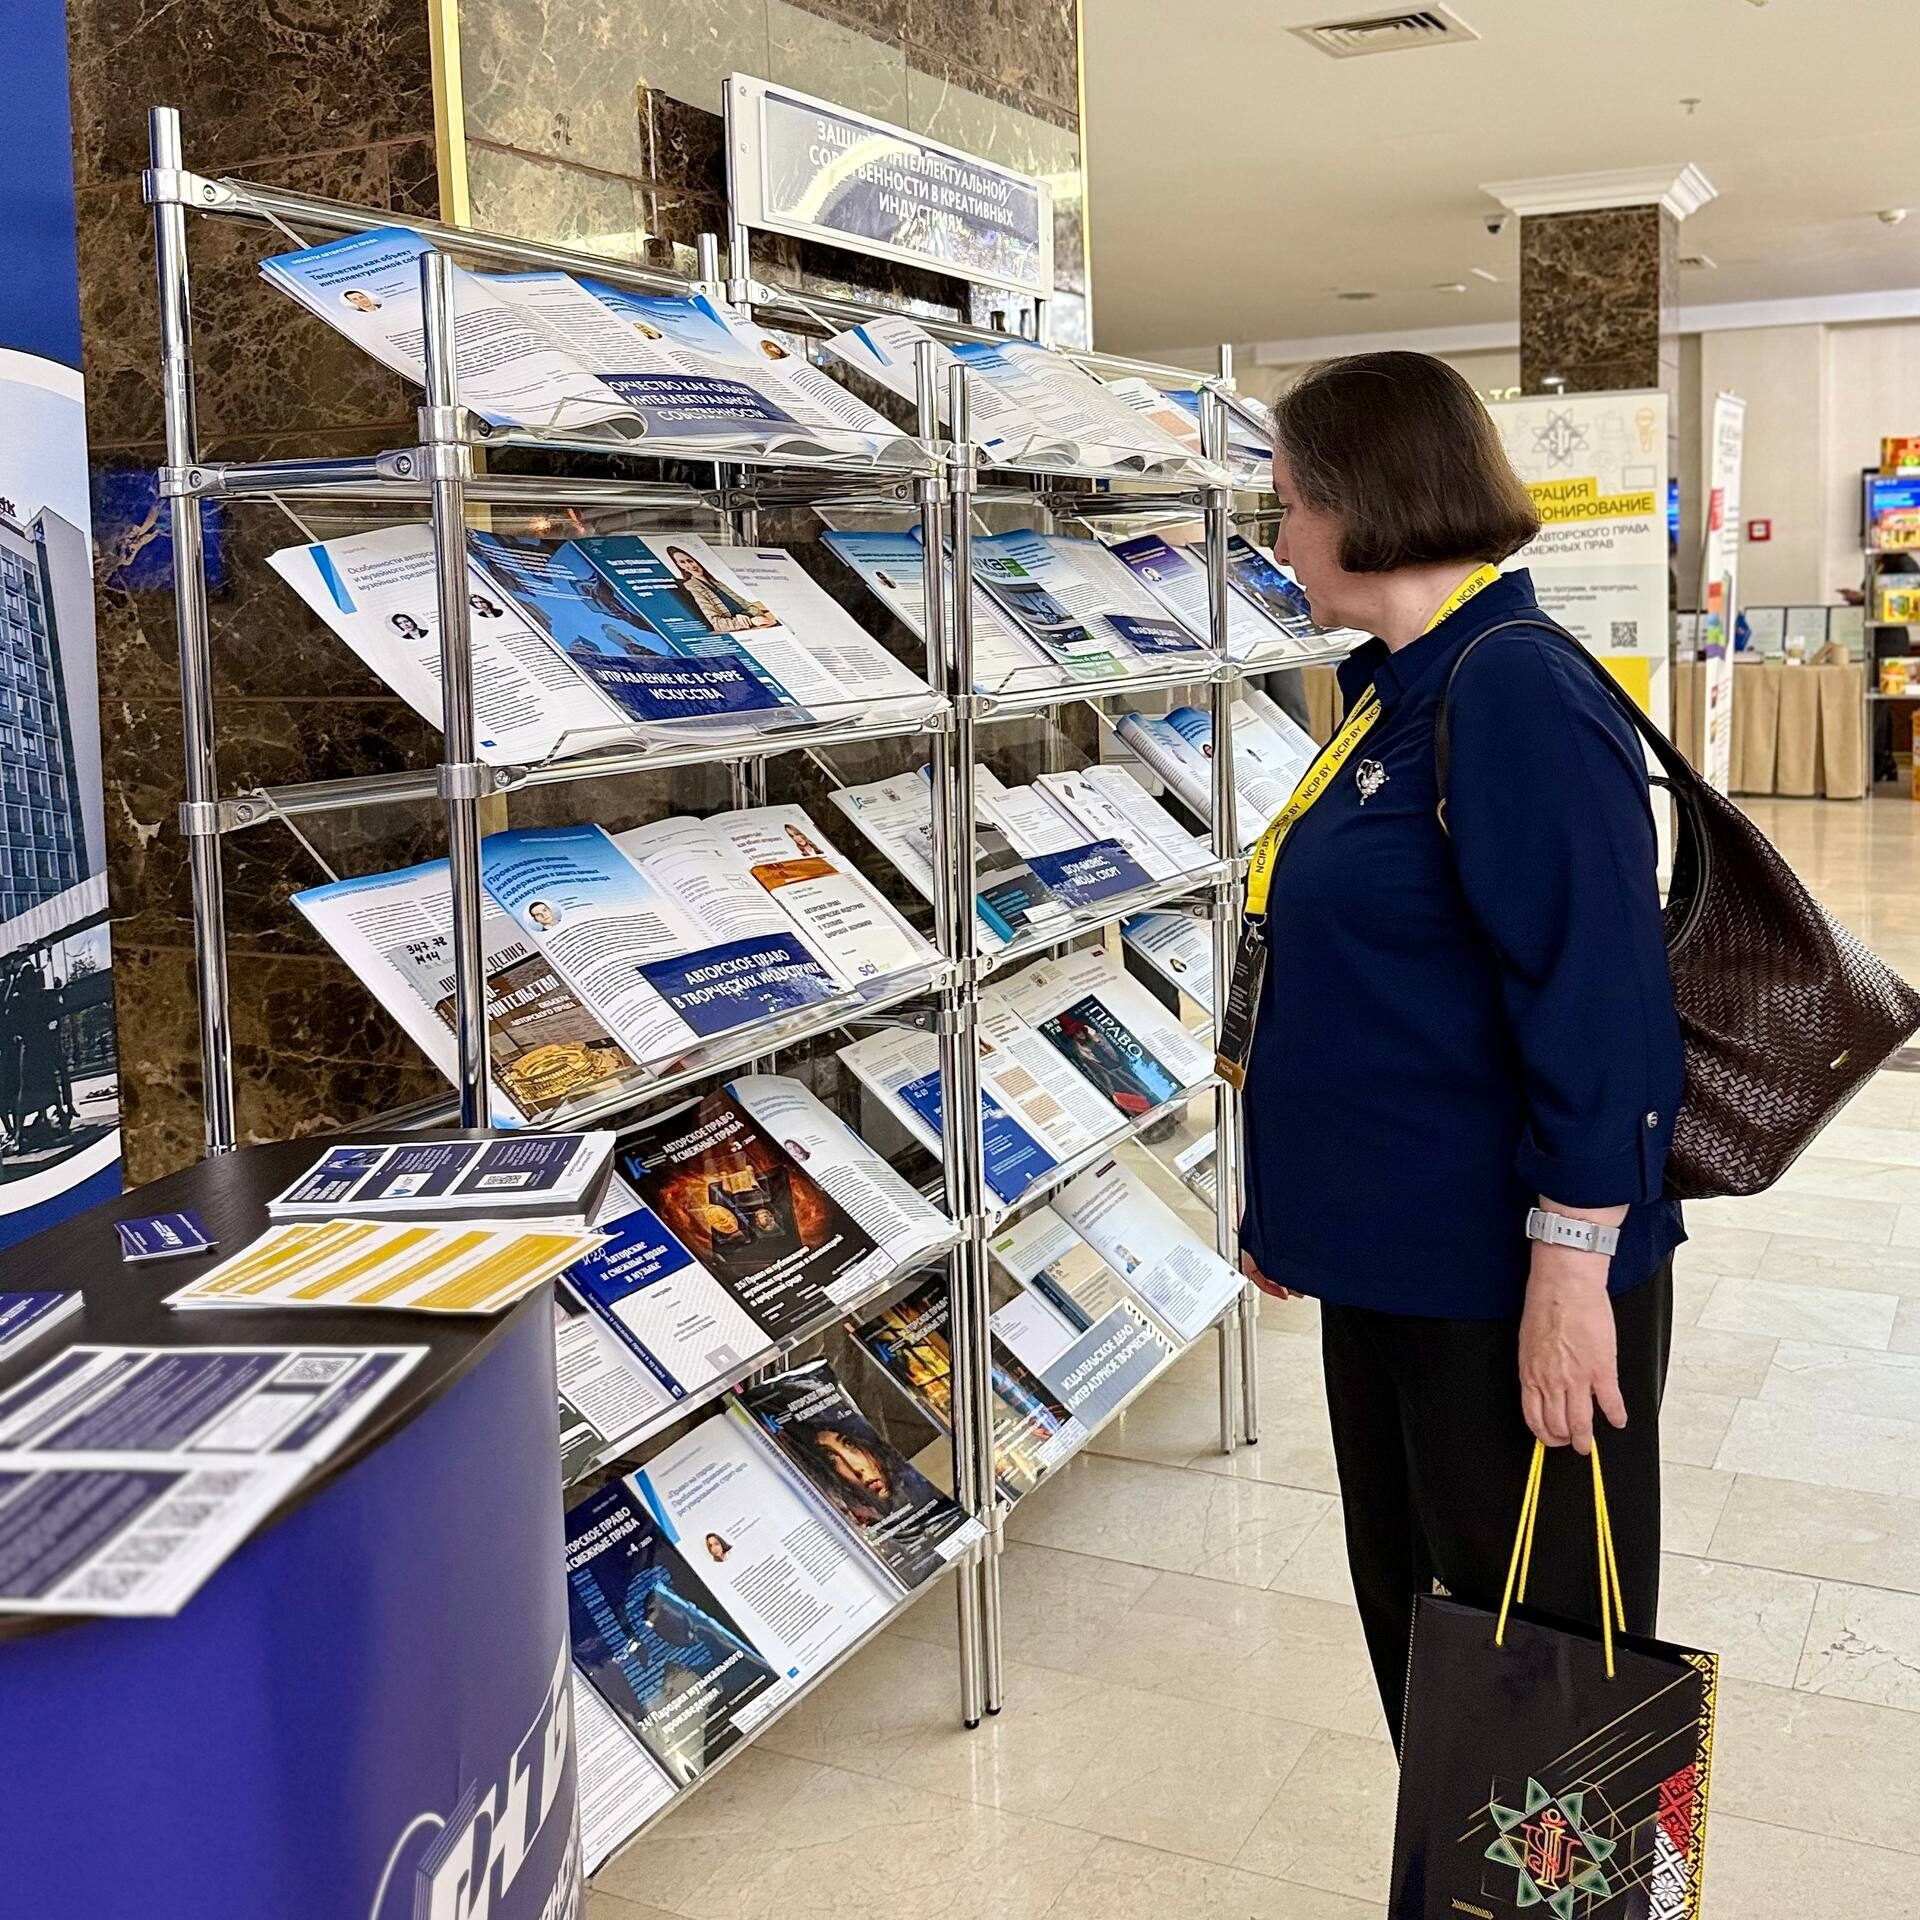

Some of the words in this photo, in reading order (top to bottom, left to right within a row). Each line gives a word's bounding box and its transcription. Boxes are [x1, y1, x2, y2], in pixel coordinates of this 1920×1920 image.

[879, 191, 963, 231] ИНДУСТРИЯХ
[931, 184, 940, 203] В
[940, 190, 1014, 227] КРЕАТИВНЫХ
[309, 262, 363, 281] Творчество
[363, 258, 381, 268] как
[380, 249, 412, 264] объект
[319, 261, 402, 287] интеллектуальной
[625, 394, 760, 408] ИНТЕЛЛЕКТУАЛЬНОЙ
[682, 382, 708, 392] КАК
[1521, 542, 1581, 557] СМЕЖНЫХ
[1584, 540, 1614, 553] ПРАВ
[1537, 526, 1610, 542] АВТОРСКОГО
[1612, 523, 1650, 536] ПРАВА
[1456, 575, 1487, 605] NCIP.BY
[594, 668, 676, 685] УПРАВЛЕНИЕ
[674, 673, 696, 684] ИС
[693, 671, 706, 684] В
[703, 670, 745, 683] СФЕРЕ
[649, 687, 726, 701] ИСКУССТВА
[1332, 724, 1362, 762] NCIP.BY
[1302, 763, 1332, 800] NCIP.BY
[1272, 802, 1301, 831] NCIP.BY
[1255, 834, 1271, 874] NCIP.BY
[671, 996, 686, 1010] В
[681, 974, 761, 1007] ТВОРЧЕСКИХ
[758, 961, 824, 985] ИНДУСТРИЯХ
[684, 957, 756, 986] АВТОРСКОЕ
[752, 949, 791, 968] ПРАВО
[1088, 1004, 1144, 1058] ПРАВО
[661, 1128, 711, 1154] АВТОРСКОЕ
[706, 1110, 736, 1133] ПРАВО
[670, 1153, 679, 1164] И
[675, 1136, 719, 1162] СМЕЖНЫЕ
[714, 1119, 745, 1142] ПРАВА
[600, 1272, 610, 1281] и
[607, 1256, 646, 1278] смежные
[643, 1244, 669, 1261] права
[604, 1241, 648, 1266] Авторские
[623, 1274, 634, 1284] в
[631, 1261, 663, 1281] музыке
[1060, 1339, 1117, 1391] ИЗДАТЕЛЬСКОЕ
[1112, 1323, 1134, 1347] ДЕЛО
[600, 1506, 631, 1533] ПРАВО
[569, 1536, 614, 1568] СМЕЖНЫЕ
[608, 1517, 640, 1543] ПРАВА
[685, 1649, 745, 1697] музыкального
[661, 1687, 722, 1735] произведения
